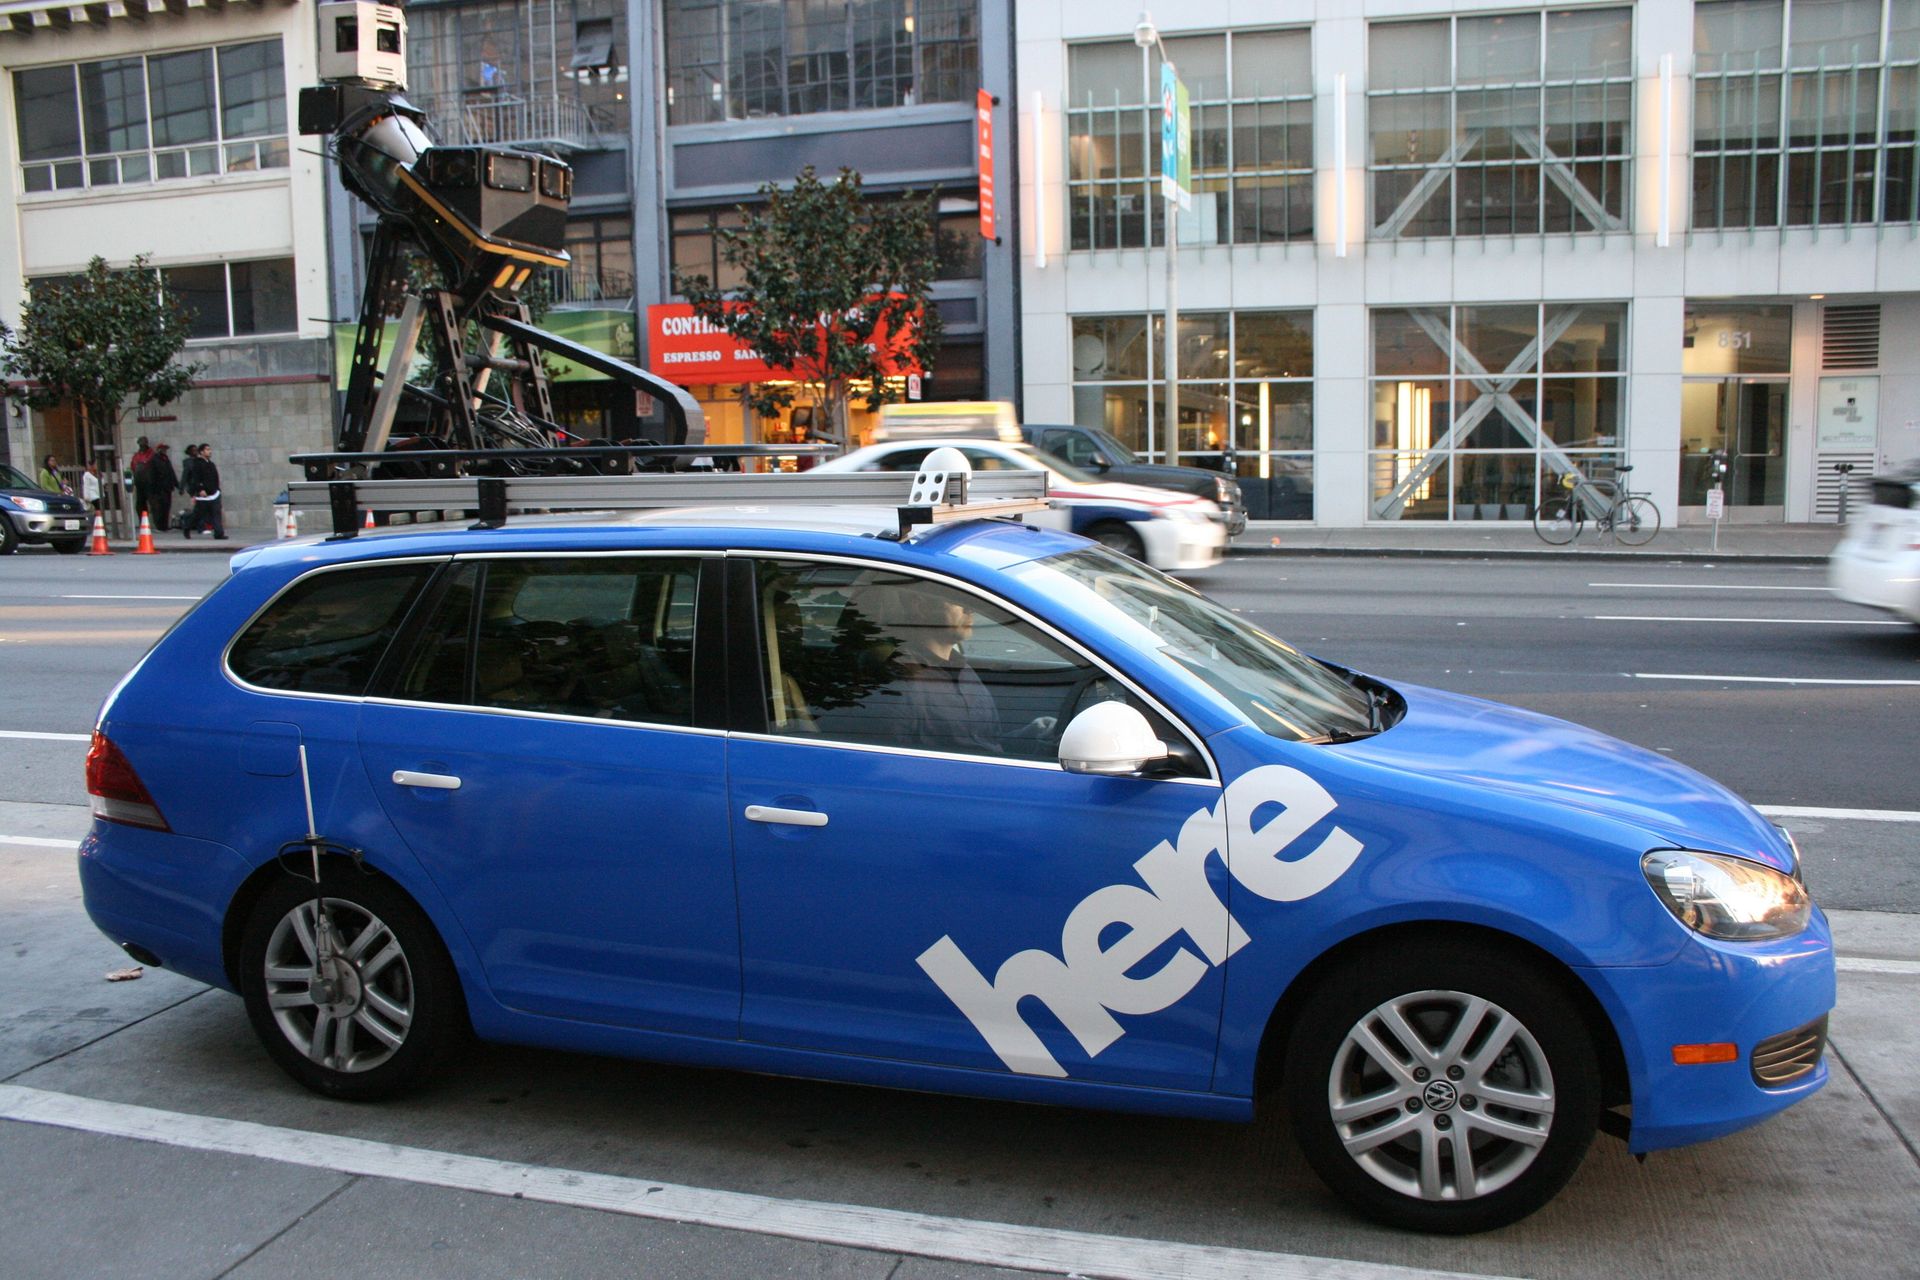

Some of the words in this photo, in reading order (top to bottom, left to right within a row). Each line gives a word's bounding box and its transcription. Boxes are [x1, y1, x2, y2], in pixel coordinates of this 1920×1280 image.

[1718, 331, 1751, 349] 851
[664, 350, 721, 363] ESPRESSO
[916, 765, 1364, 1077] here
